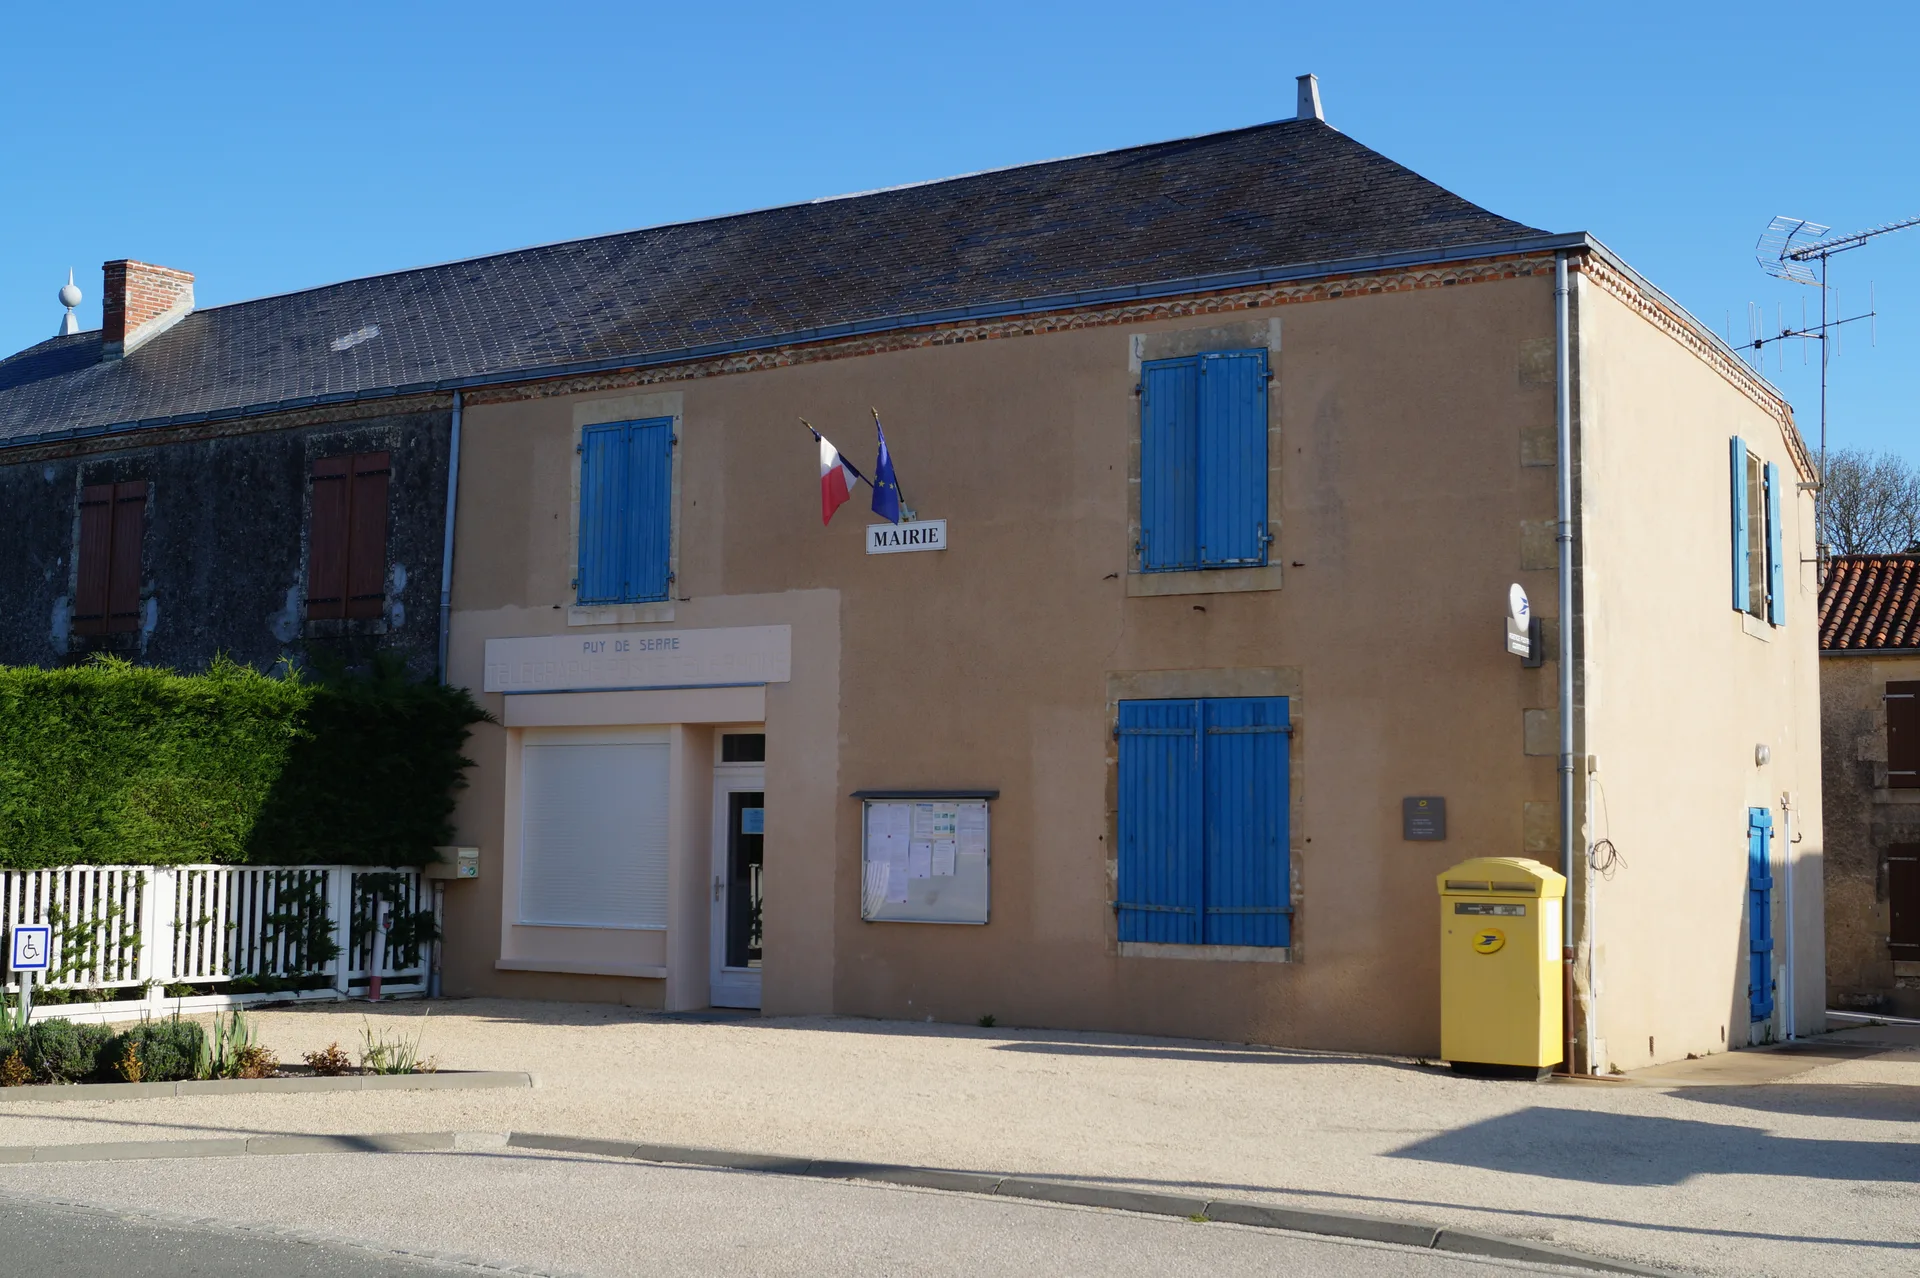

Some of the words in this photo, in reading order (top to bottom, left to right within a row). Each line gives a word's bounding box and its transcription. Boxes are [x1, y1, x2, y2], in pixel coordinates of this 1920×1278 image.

[874, 528, 939, 547] MAIRIE
[582, 640, 606, 654] PUY
[615, 639, 631, 653] DE
[639, 637, 681, 651] SERRE
